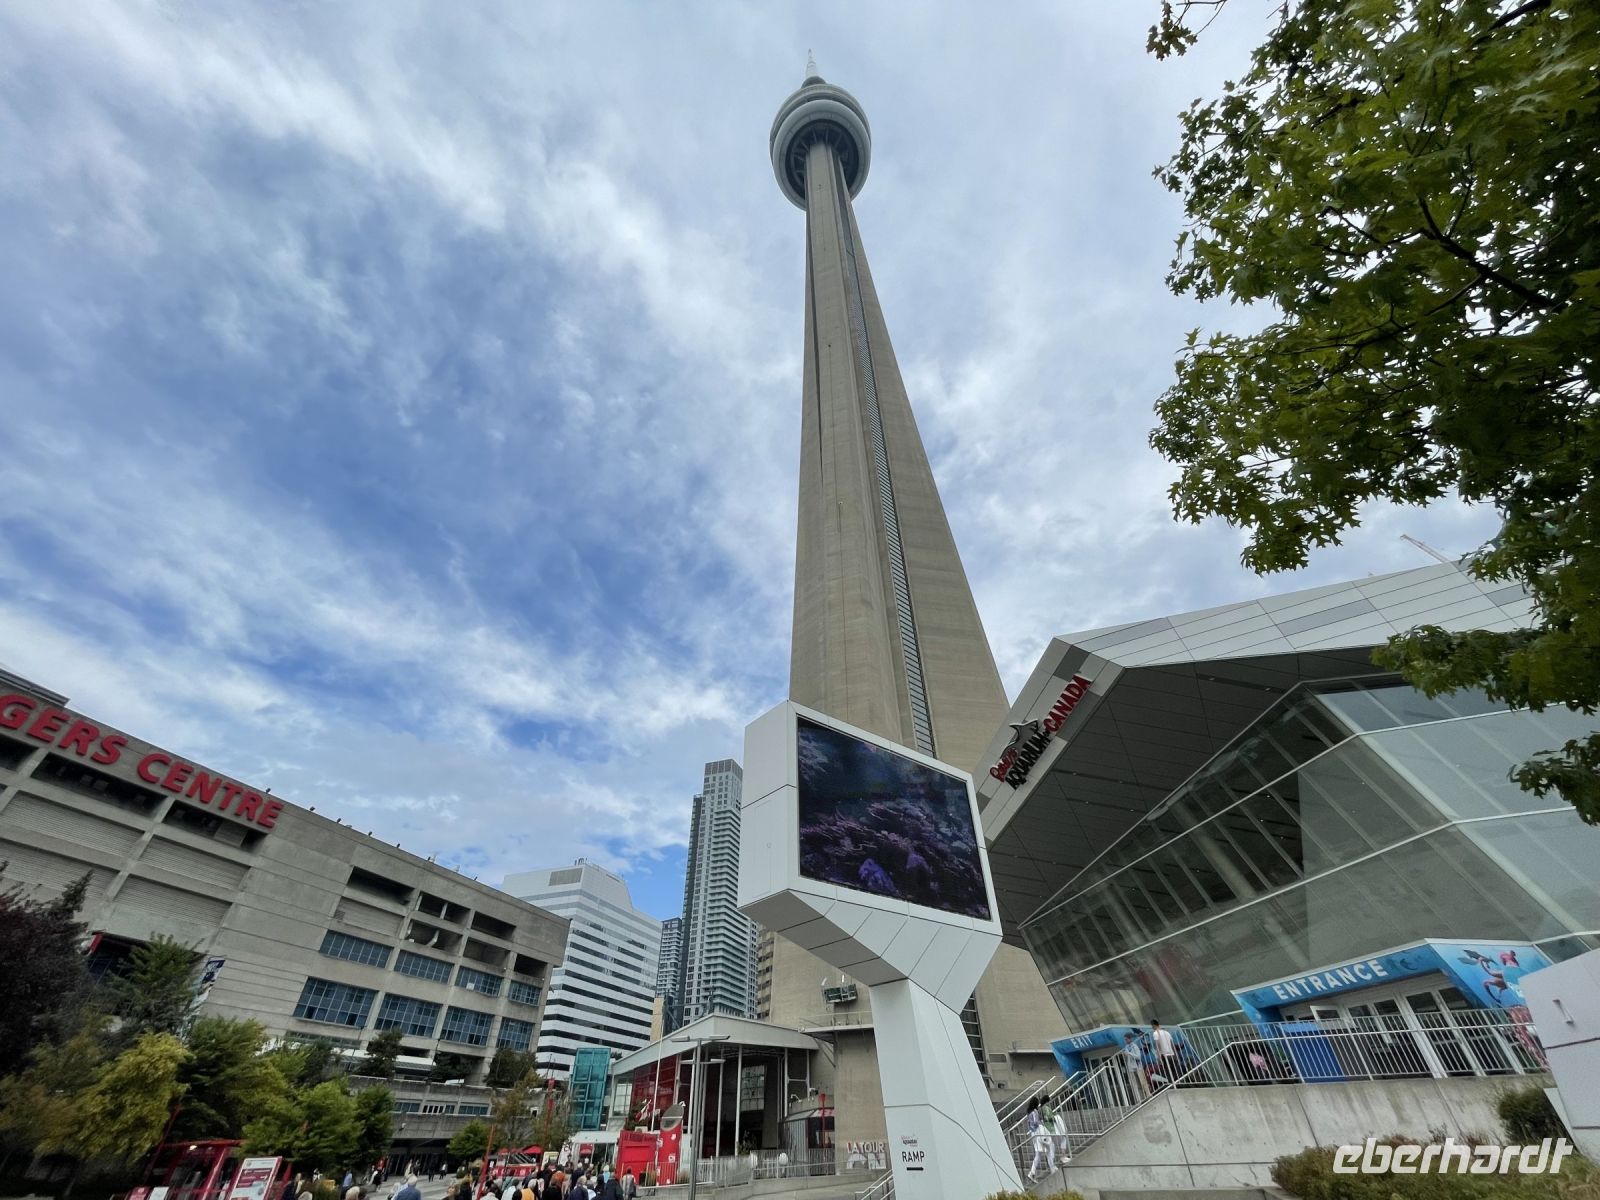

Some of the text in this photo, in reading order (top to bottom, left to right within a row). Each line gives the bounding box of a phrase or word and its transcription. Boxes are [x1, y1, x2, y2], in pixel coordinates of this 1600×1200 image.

[1005, 727, 1051, 790] AQUARIUM
[1043, 673, 1092, 732] CANADA
[0, 694, 284, 829] GERS CENTRE
[1272, 959, 1389, 1000] ENTRANCE
[1070, 1034, 1094, 1049] EXIT
[901, 1150, 925, 1163] RAMP
